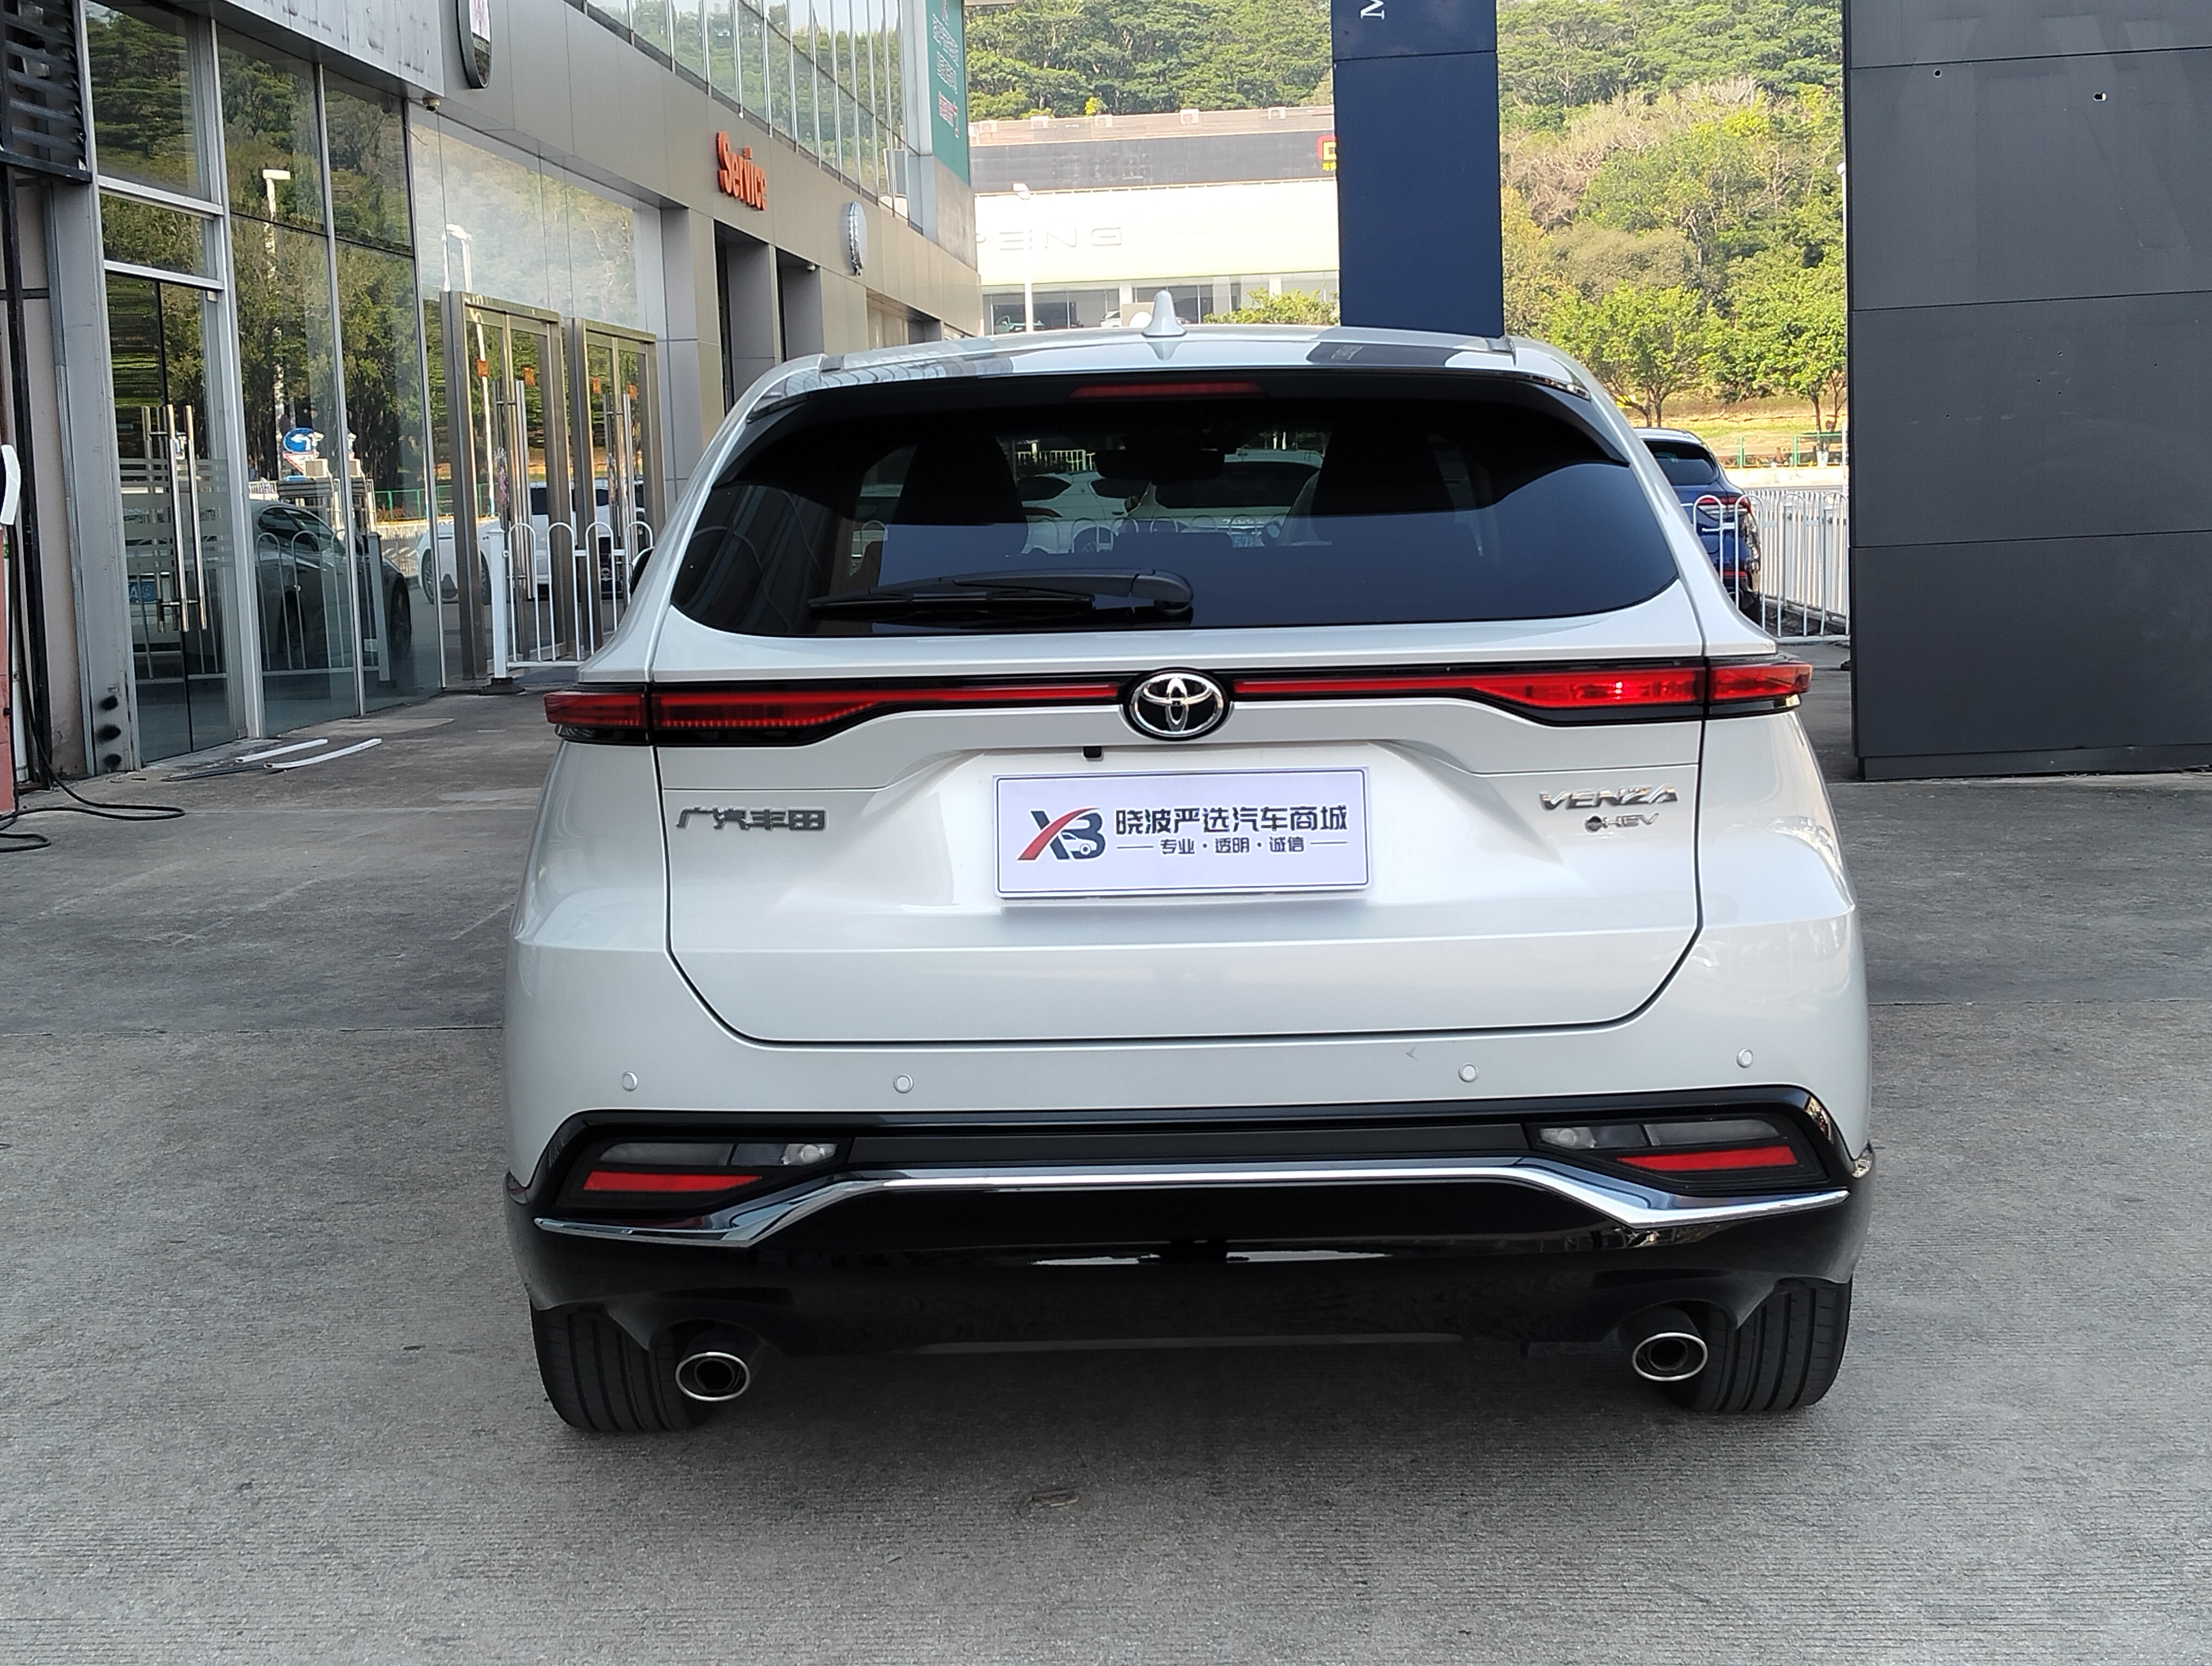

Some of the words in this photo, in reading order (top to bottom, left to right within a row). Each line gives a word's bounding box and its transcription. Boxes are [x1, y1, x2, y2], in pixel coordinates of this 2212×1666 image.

[717, 130, 767, 210] Service
[1539, 783, 1678, 810] VENZA
[676, 806, 826, 831] 广汽丰田
[1115, 805, 1348, 835] 晓波严选汽车商城
